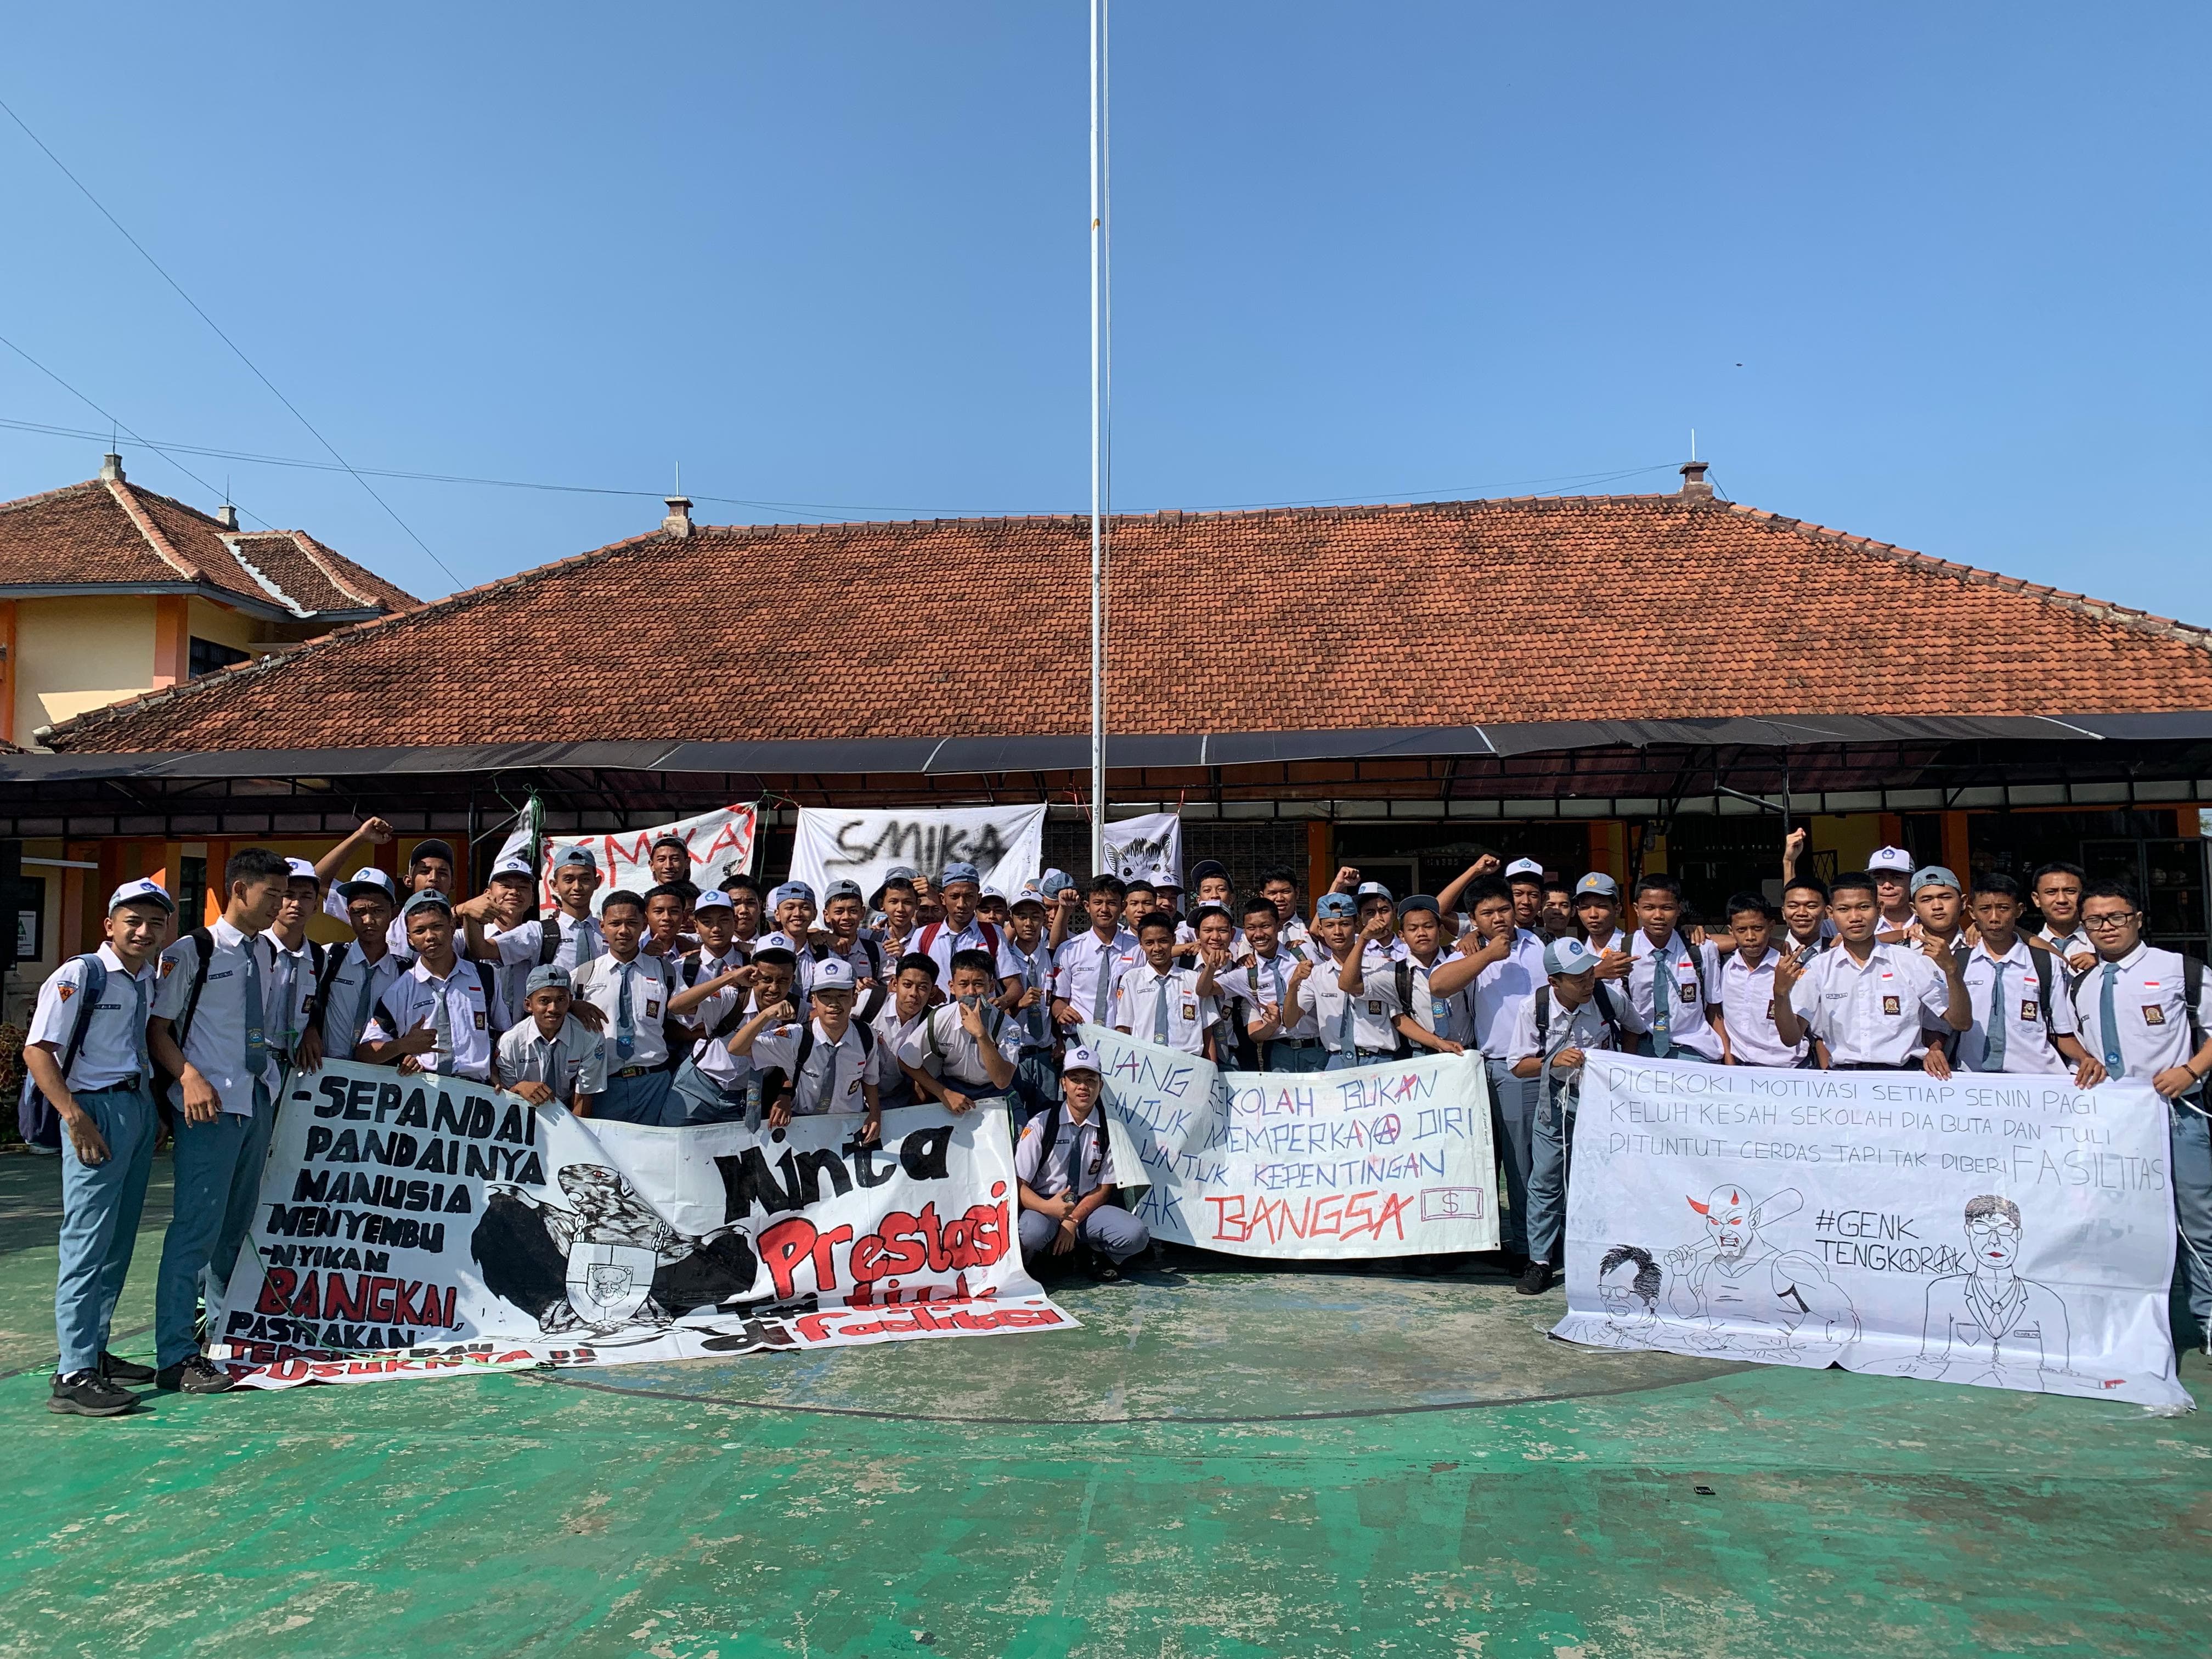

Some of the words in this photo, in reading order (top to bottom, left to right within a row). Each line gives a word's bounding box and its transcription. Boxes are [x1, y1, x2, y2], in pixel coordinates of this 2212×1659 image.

[824, 819, 1012, 874] SMIKA
[1208, 1079, 1314, 1118] SEKOLAH
[1336, 1069, 1437, 1113] BUKAN
[1609, 1068, 1732, 1093] DICEKOKI
[1751, 1078, 1857, 1099] MOTIVASI
[1872, 1085, 1955, 1103] SETIAP
[1966, 1088, 2030, 1108] SENIN
[2042, 1090, 2097, 1115] PAGI
[1204, 1113, 1401, 1154] MEMPERKAYA
[1413, 1107, 1472, 1140] DIRI
[1610, 1100, 1688, 1124] KELUH
[1700, 1103, 1776, 1125] KESAH
[1791, 1106, 1892, 1128] SEKOLAH
[1902, 1112, 1934, 1130] DIA
[1941, 1114, 1992, 1135] BUTA
[2004, 1119, 2040, 1140] DAN
[2051, 1125, 2111, 1145] TULI
[304, 1125, 547, 1186] PANDAINYA
[713, 1125, 954, 1224] Minta
[1254, 1149, 1444, 1190] KEPENTINGAN
[1610, 1132, 1728, 1158] DITUNTUT
[1740, 1141, 1821, 1162] CERDAS
[1832, 1145, 1881, 1163] TAPI
[1889, 1150, 1927, 1167] TAK
[1942, 1155, 2007, 1175] DIBERI
[2013, 1145, 2164, 1190] FASILITAS
[292, 1168, 472, 1214] MANUSIA
[263, 1203, 445, 1254] MENYEMBU
[757, 1181, 1011, 1301] Prestasi
[1205, 1190, 1414, 1245] BANGSA
[1815, 1209, 1920, 1241] #GENK
[1815, 1239, 1968, 1275] TENGKORAK
[409, 1343, 493, 1358] BAU
